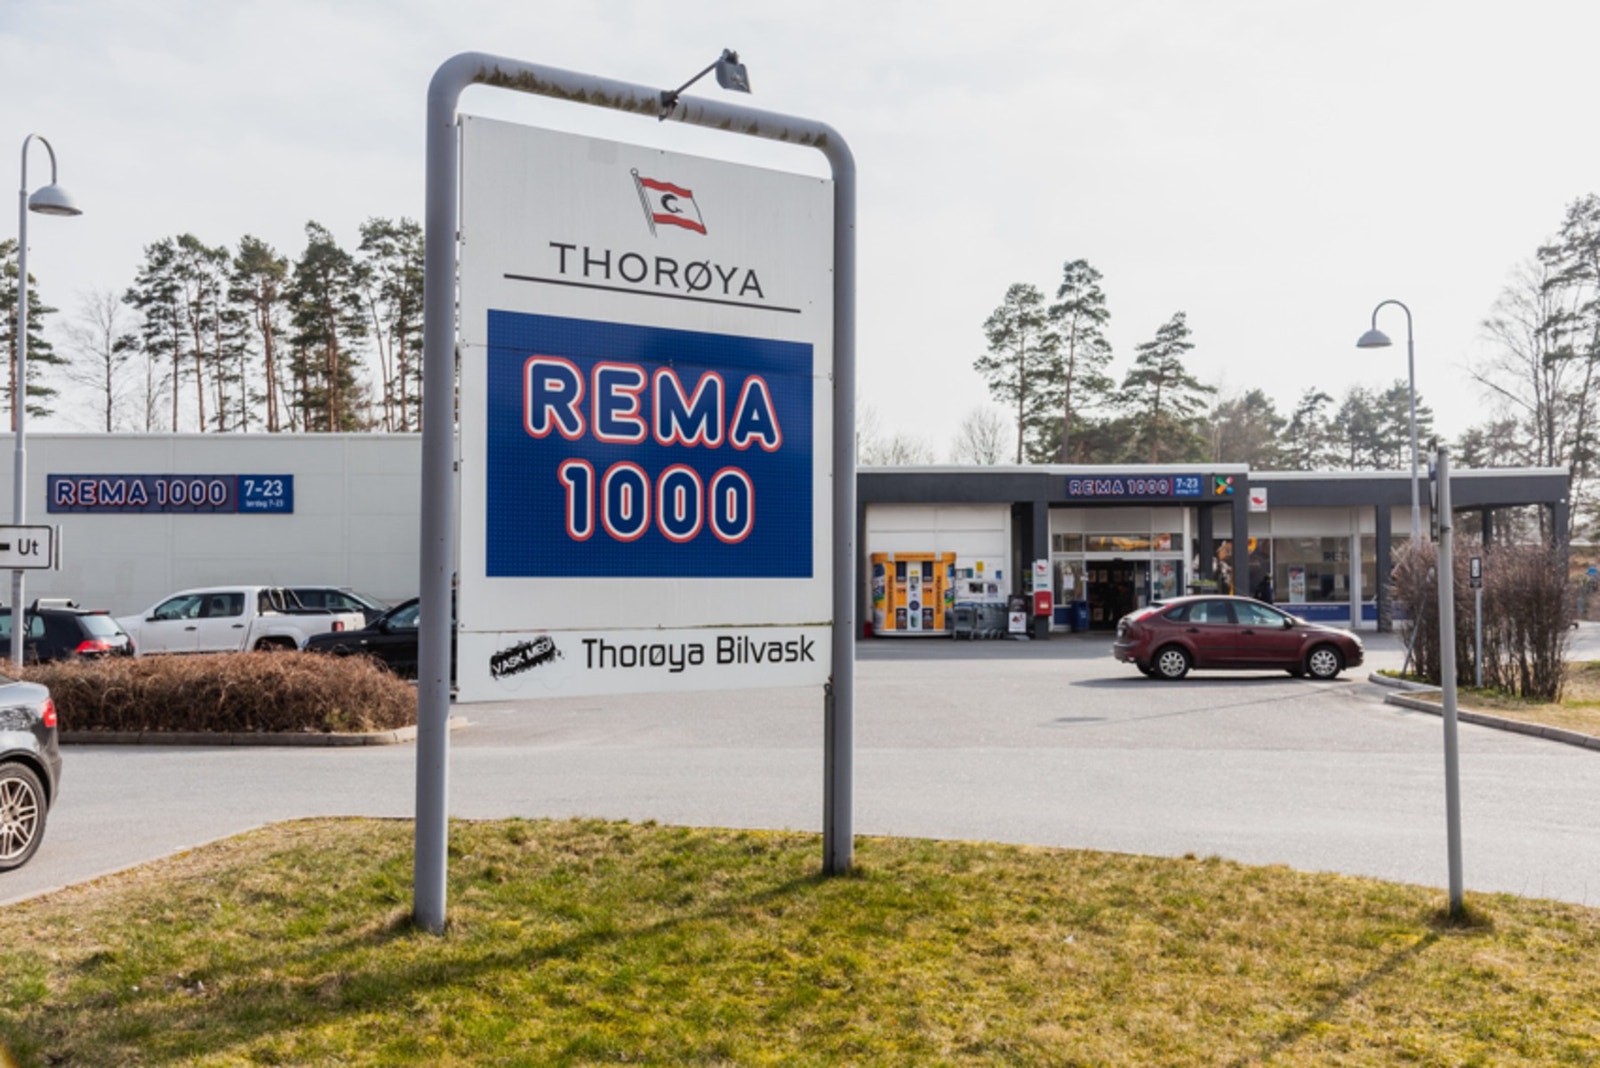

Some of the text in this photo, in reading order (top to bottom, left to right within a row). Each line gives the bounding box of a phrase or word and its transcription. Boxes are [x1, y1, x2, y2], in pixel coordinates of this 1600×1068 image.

[549, 241, 765, 299] THORØYA
[523, 355, 782, 453] REMA
[56, 479, 227, 506] REMA 1000
[244, 479, 283, 497] 7-23
[1069, 479, 1170, 495] REMA 1000
[1175, 477, 1199, 489] 7-23
[557, 458, 755, 544] 1000
[18, 538, 39, 556] Ut
[581, 635, 815, 673] Thorøya Bilvask
